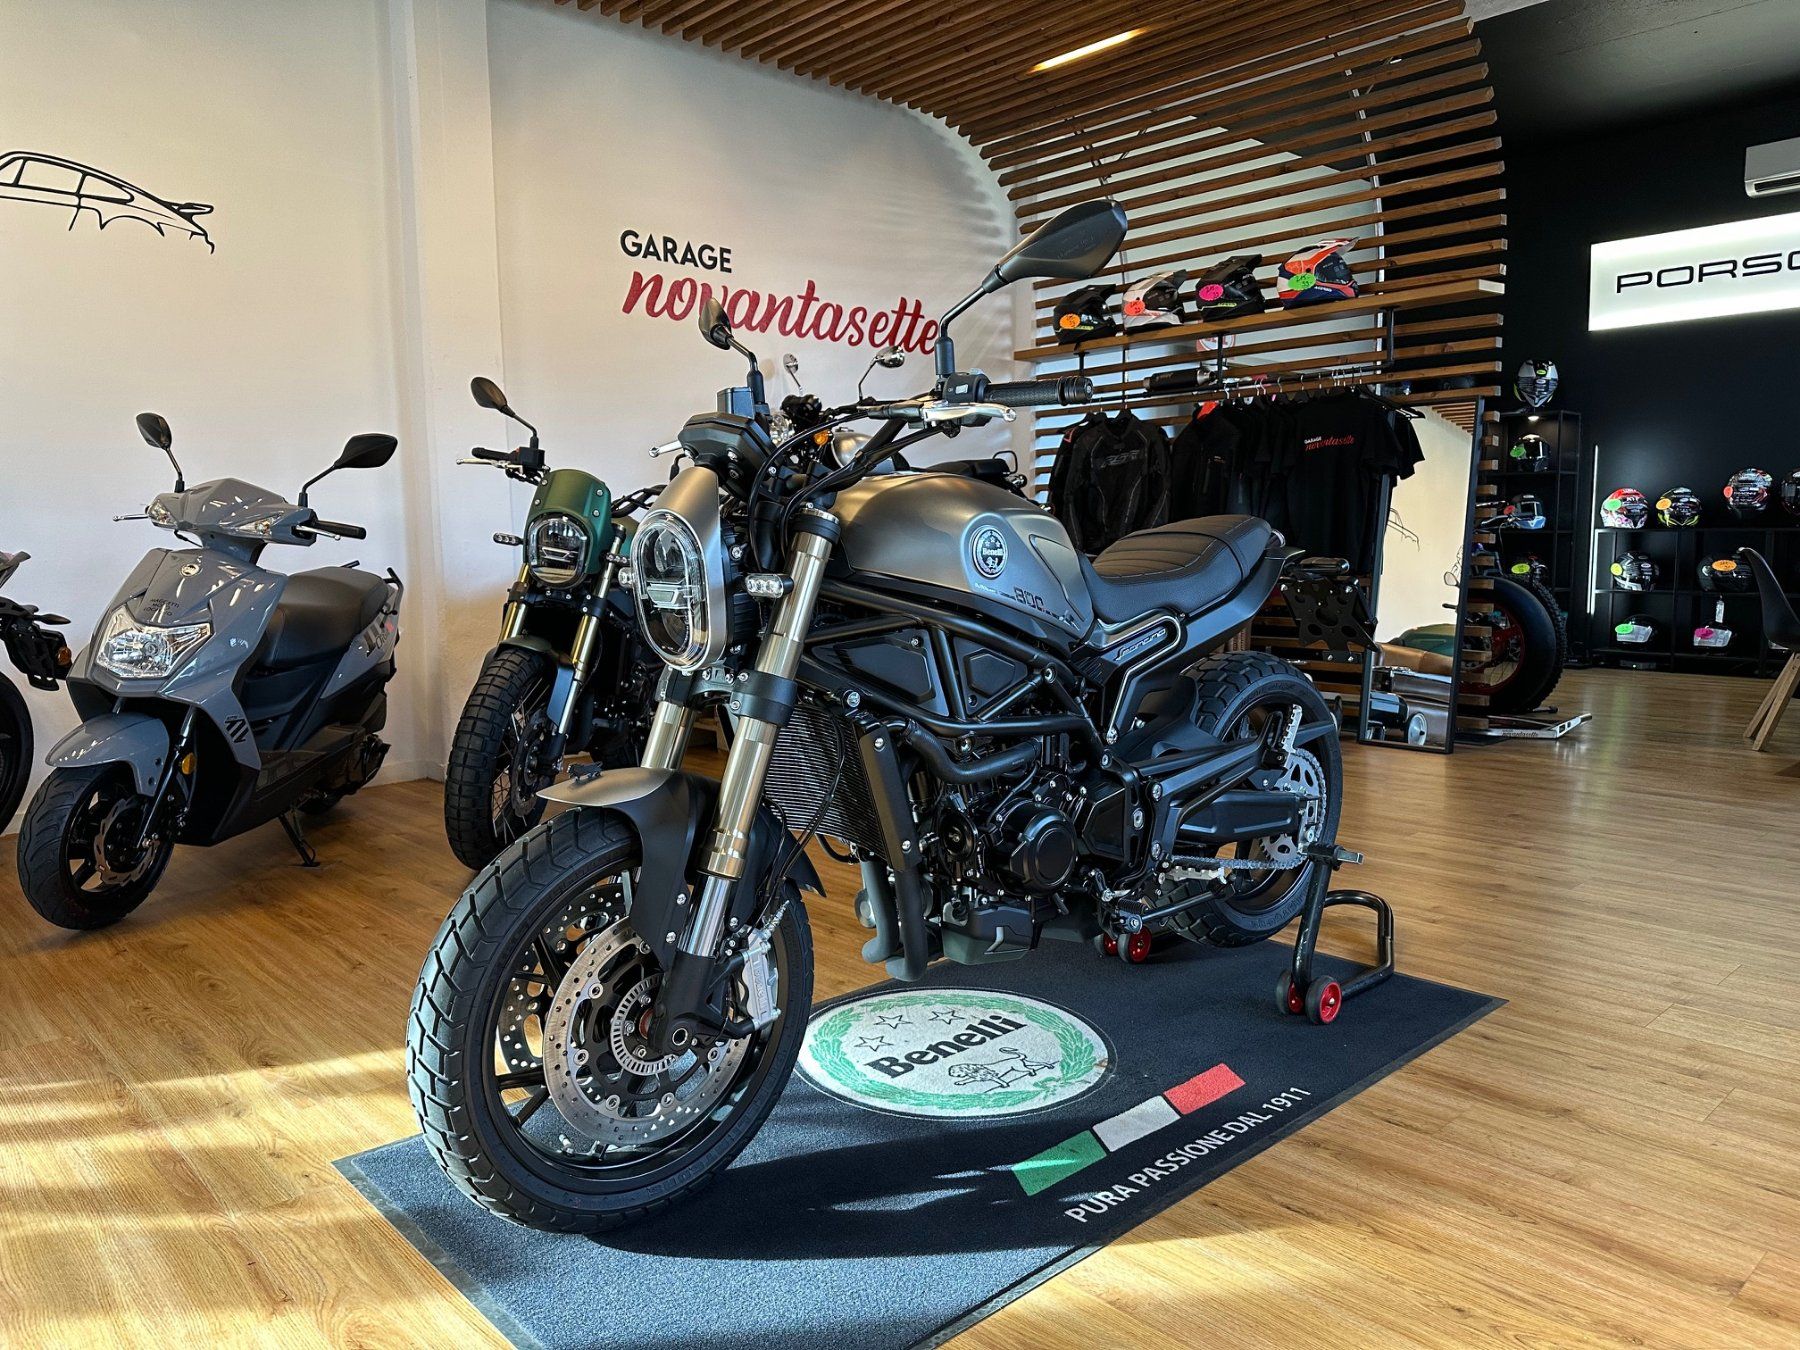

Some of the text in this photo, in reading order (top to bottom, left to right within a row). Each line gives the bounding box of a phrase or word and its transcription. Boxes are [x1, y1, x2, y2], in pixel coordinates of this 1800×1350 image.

[619, 230, 733, 274] GARAGE
[865, 1014, 1028, 1079] Benelli
[1064, 1086, 1312, 1223] PURA PASSIONE DAL 1911
